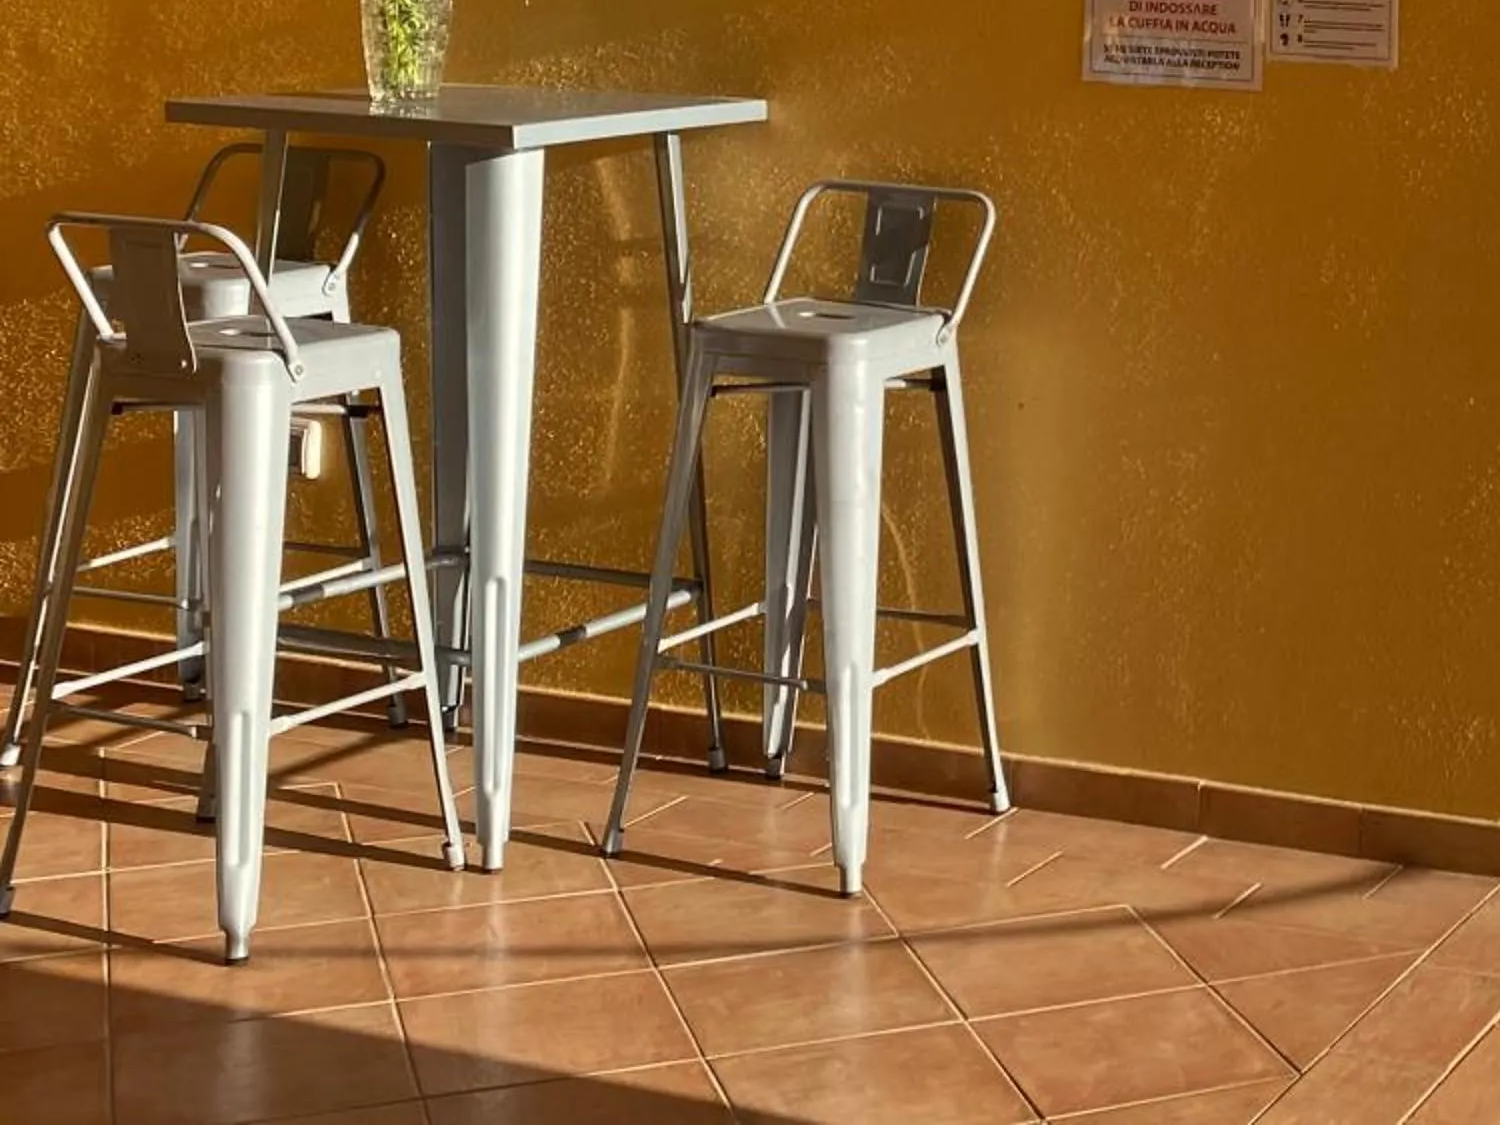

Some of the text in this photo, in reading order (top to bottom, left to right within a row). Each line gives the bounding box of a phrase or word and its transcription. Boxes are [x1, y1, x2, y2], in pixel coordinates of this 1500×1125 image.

[1129, 1, 1218, 15] DI INDOSSARE
[1128, 17, 1173, 31] CUFFIA
[1175, 19, 1188, 32] IN
[1193, 20, 1236, 35] ACQUA
